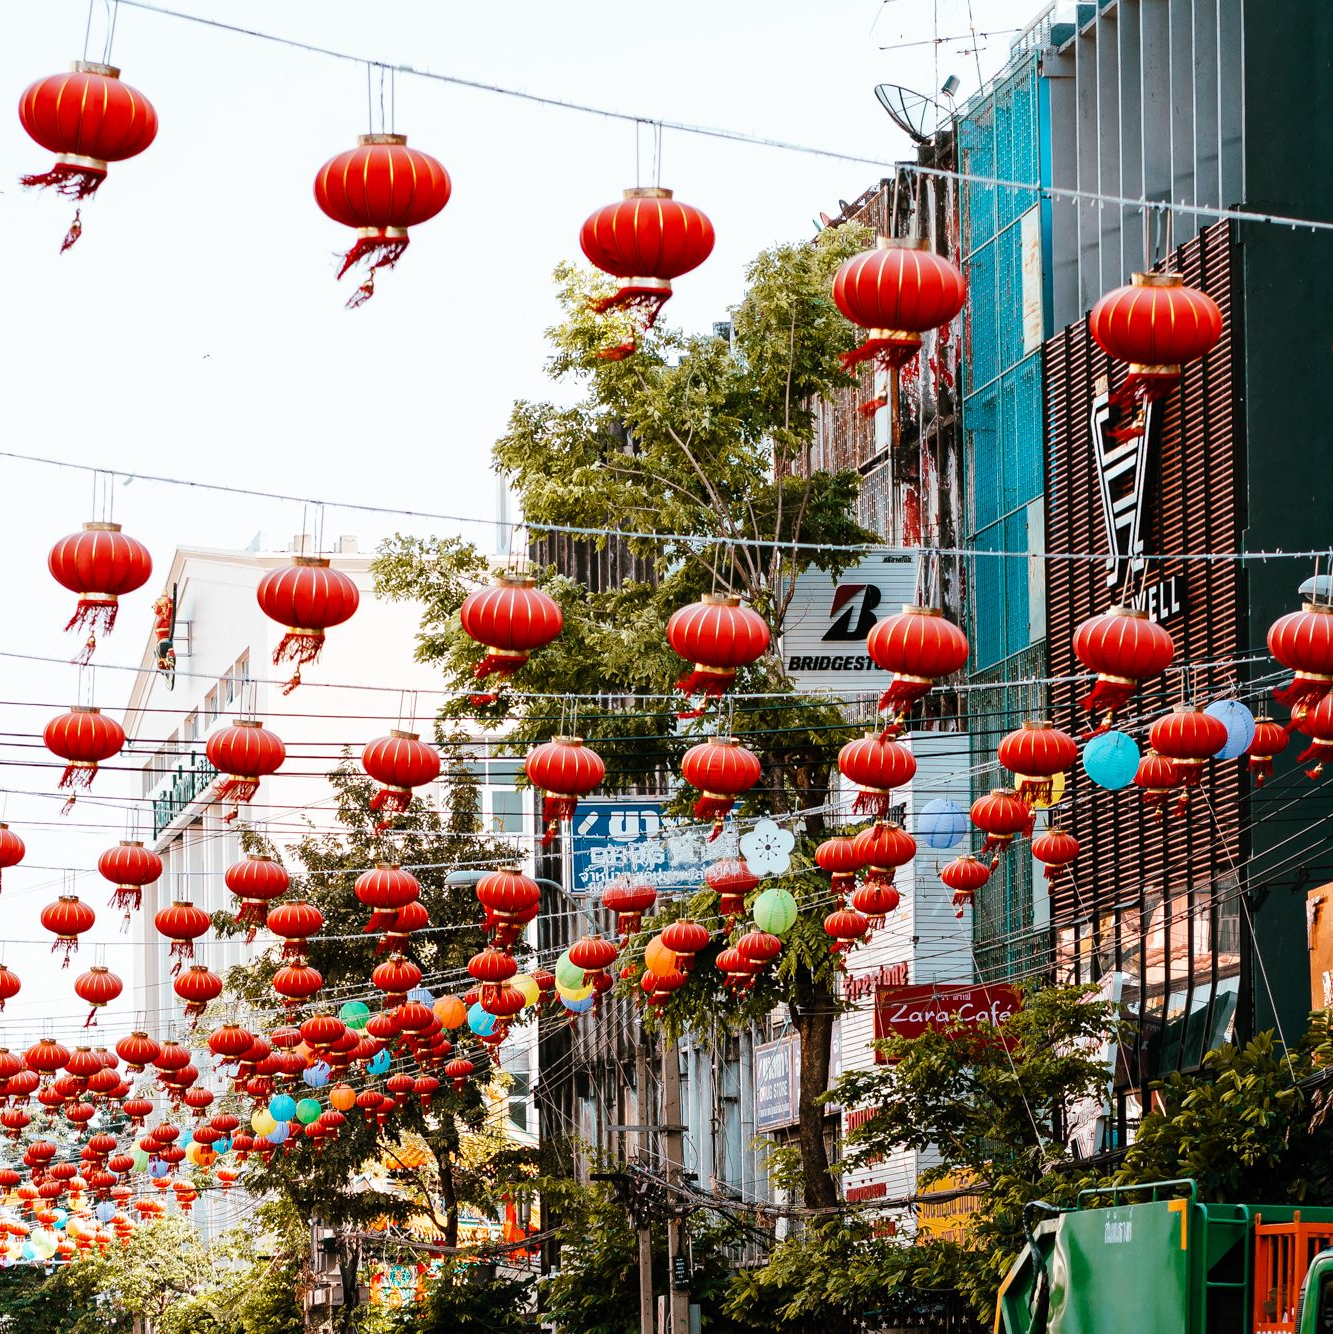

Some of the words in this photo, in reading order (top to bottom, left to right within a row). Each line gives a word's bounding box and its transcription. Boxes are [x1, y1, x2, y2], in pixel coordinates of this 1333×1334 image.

[788, 656, 884, 671] BRIDGEST
[890, 1003, 950, 1023] Zara
[957, 1000, 1012, 1028] Café
